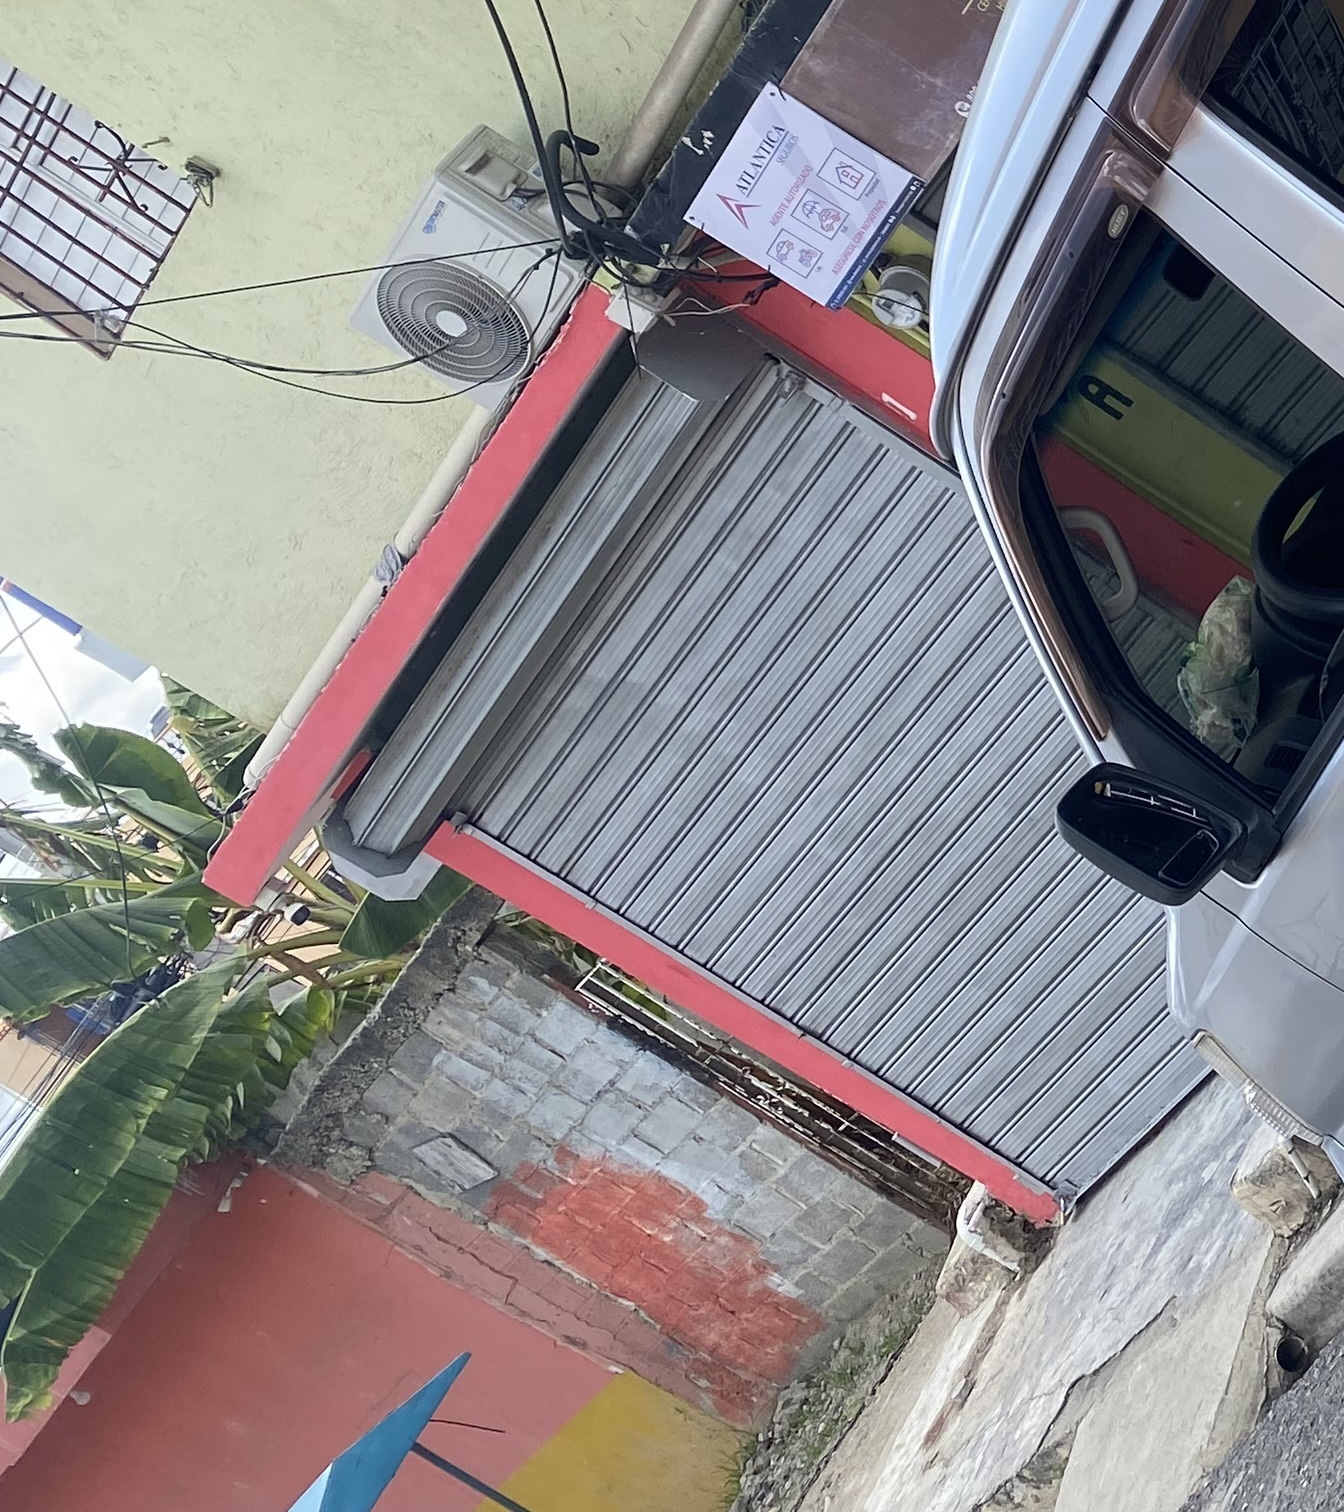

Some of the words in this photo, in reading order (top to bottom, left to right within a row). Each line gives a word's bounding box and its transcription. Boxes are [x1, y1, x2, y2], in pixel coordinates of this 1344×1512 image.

[734, 123, 786, 196] ATLANTICA
[774, 133, 799, 166] SEGUROS
[769, 202, 789, 227] AGENTE
[784, 164, 813, 204] AUTORIZADO
[852, 229, 866, 244] CON
[860, 199, 886, 231] NOSOTROS
[1110, 208, 1126, 234] HIJET
